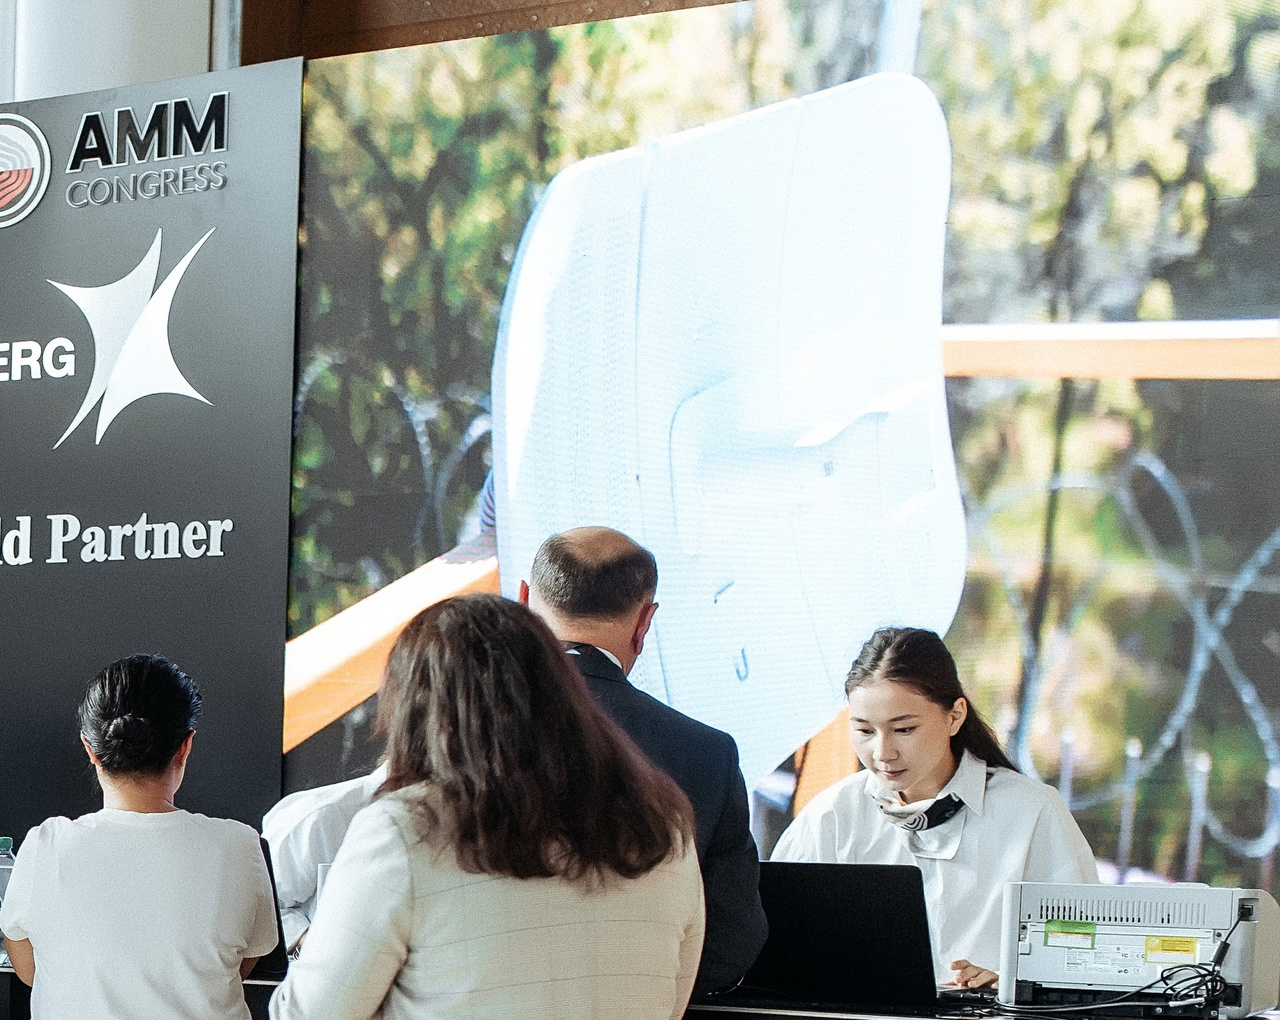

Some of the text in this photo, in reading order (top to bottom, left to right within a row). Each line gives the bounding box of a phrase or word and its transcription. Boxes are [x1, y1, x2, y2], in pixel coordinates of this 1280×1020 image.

[65, 91, 230, 174] AMM
[65, 160, 228, 209] CONGRESS
[45, 512, 234, 563] Partner
